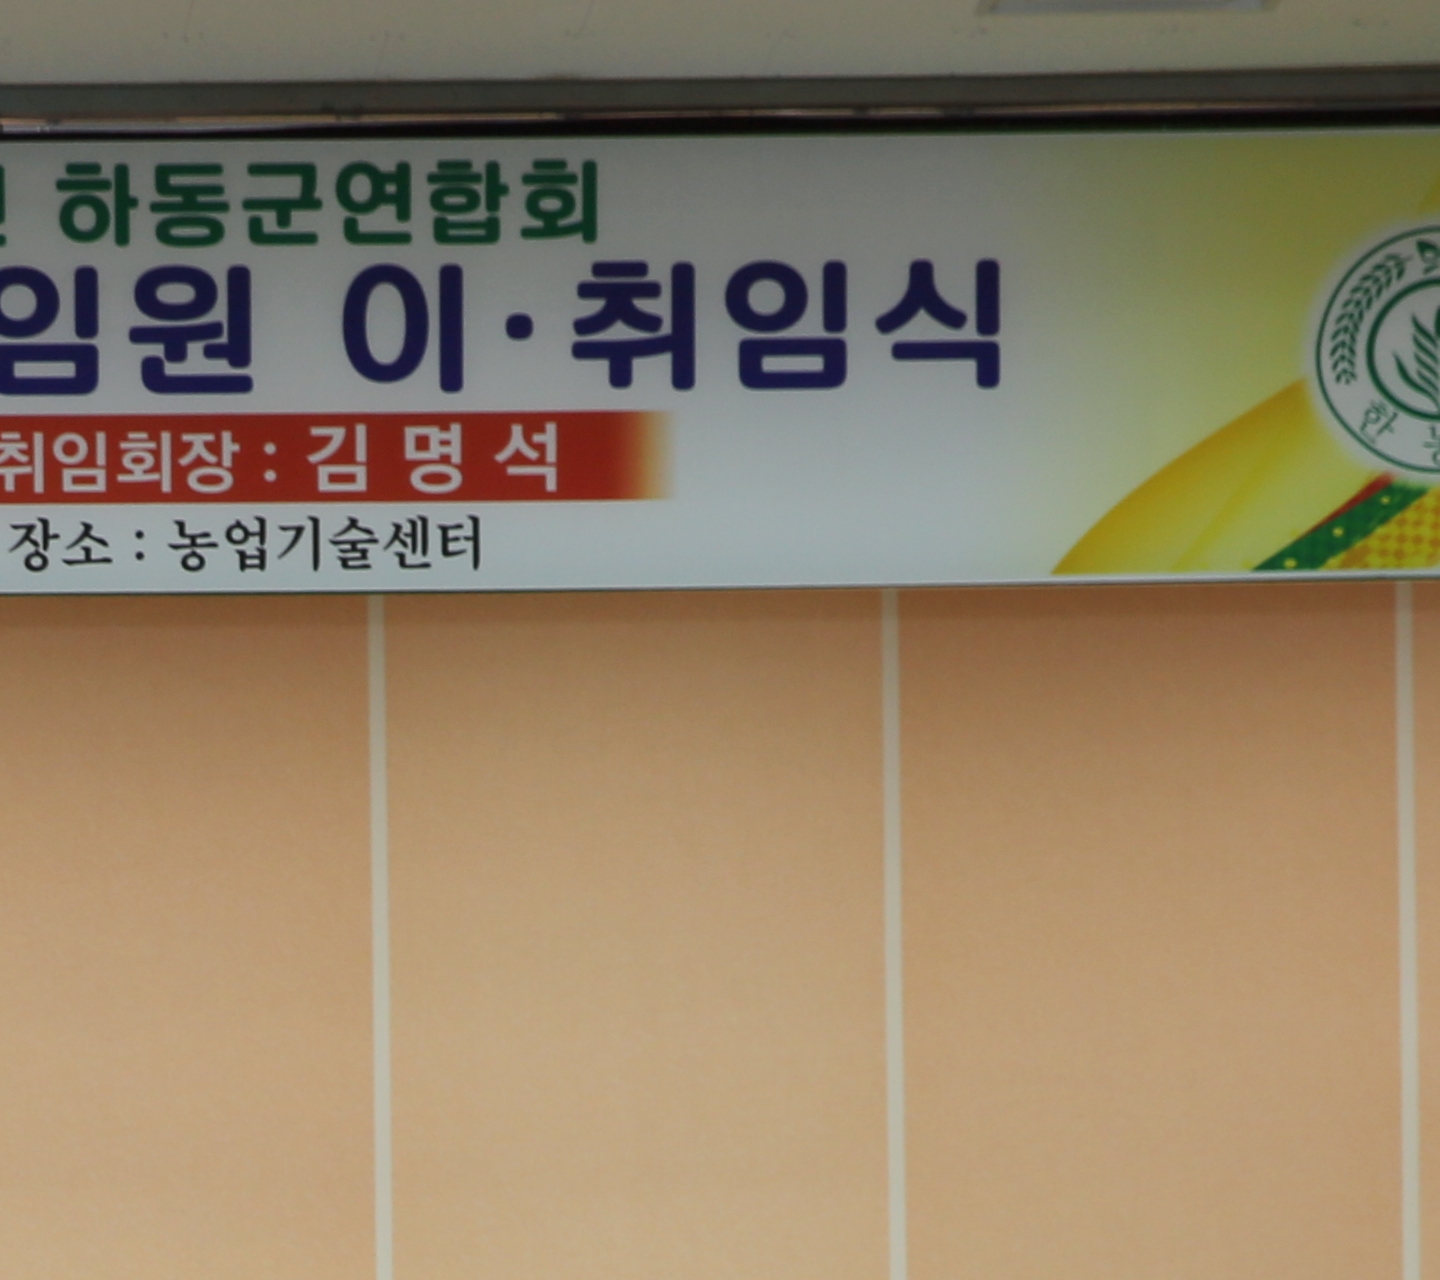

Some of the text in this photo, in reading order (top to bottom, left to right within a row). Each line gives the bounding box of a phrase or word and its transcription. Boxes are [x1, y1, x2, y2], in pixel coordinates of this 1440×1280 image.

[56, 159, 600, 248] 하동군연합회
[340, 255, 1005, 393] 이·취임식
[10, 517, 114, 573] 장소
[168, 515, 482, 572] 농업기술센터
